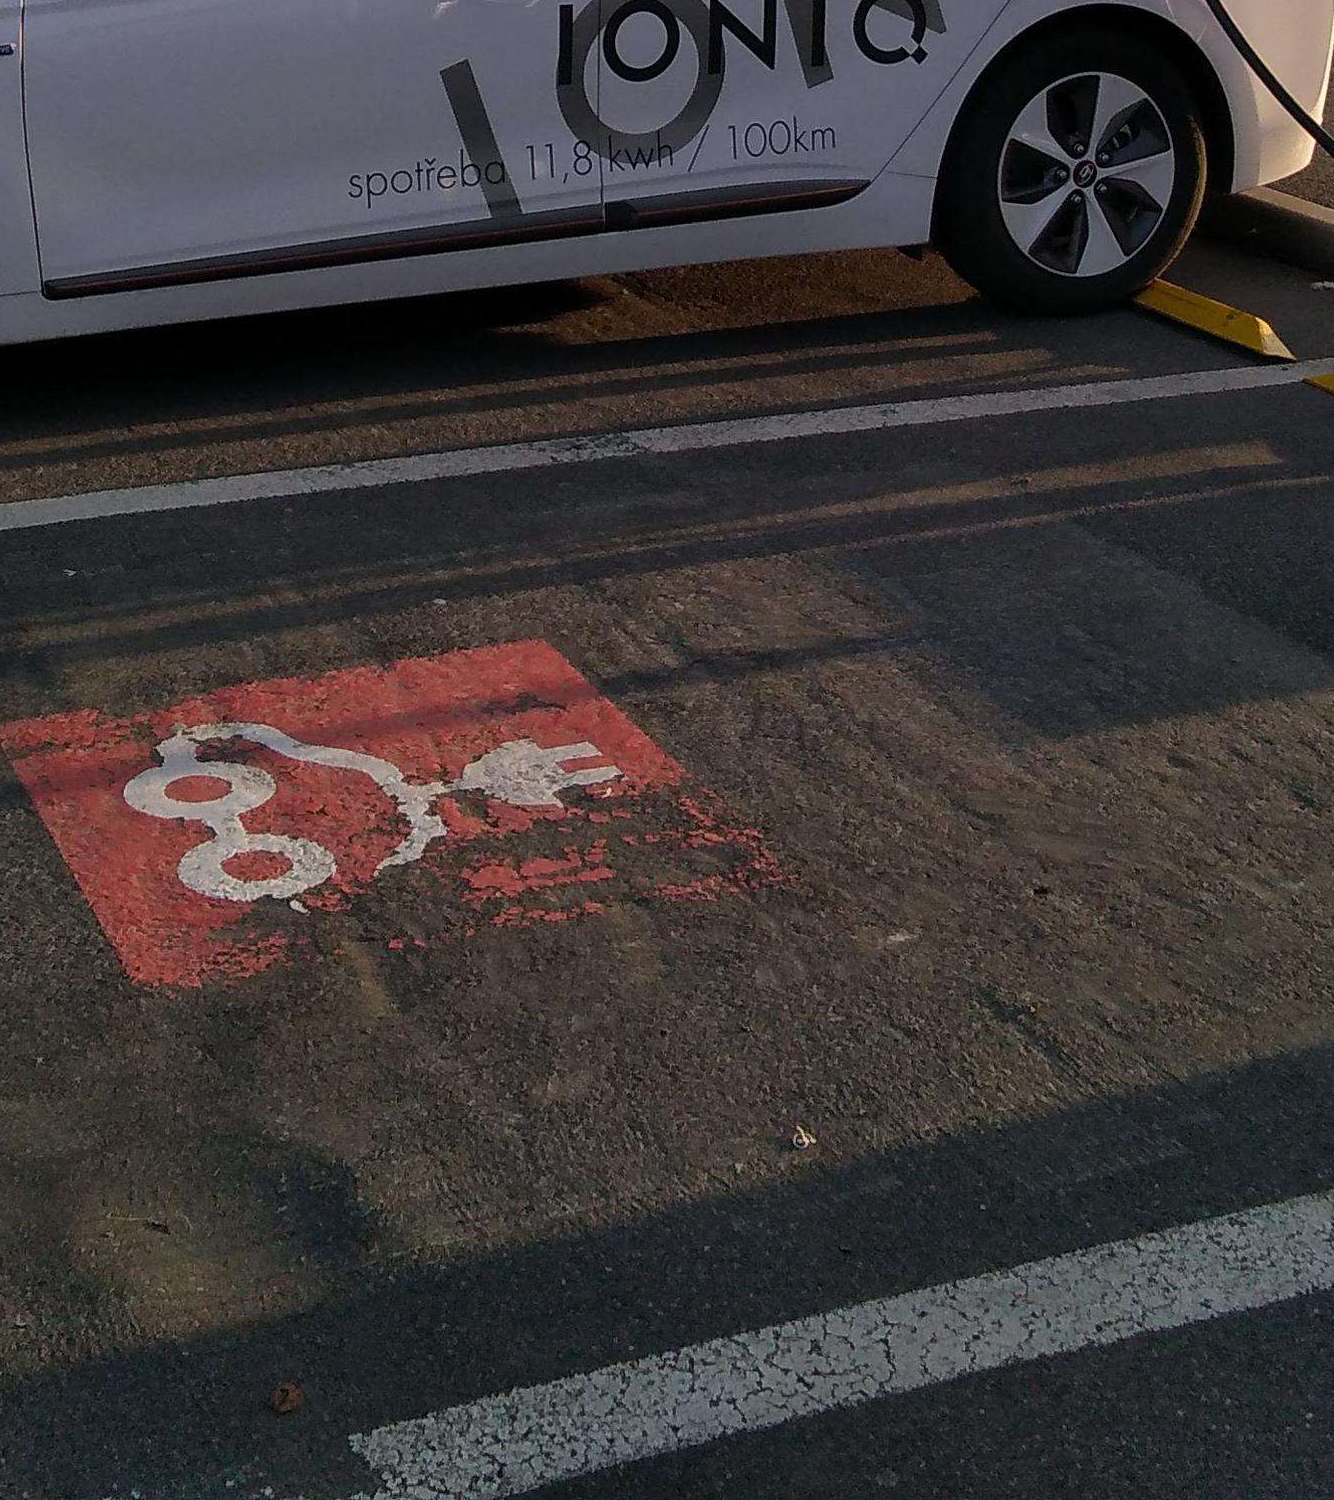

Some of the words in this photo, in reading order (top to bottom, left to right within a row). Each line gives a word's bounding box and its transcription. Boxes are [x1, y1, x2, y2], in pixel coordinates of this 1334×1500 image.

[348, 149, 506, 209] spotřeba
[526, 140, 593, 184] 11,8
[608, 130, 674, 172] kwh
[728, 115, 836, 160] 100km
